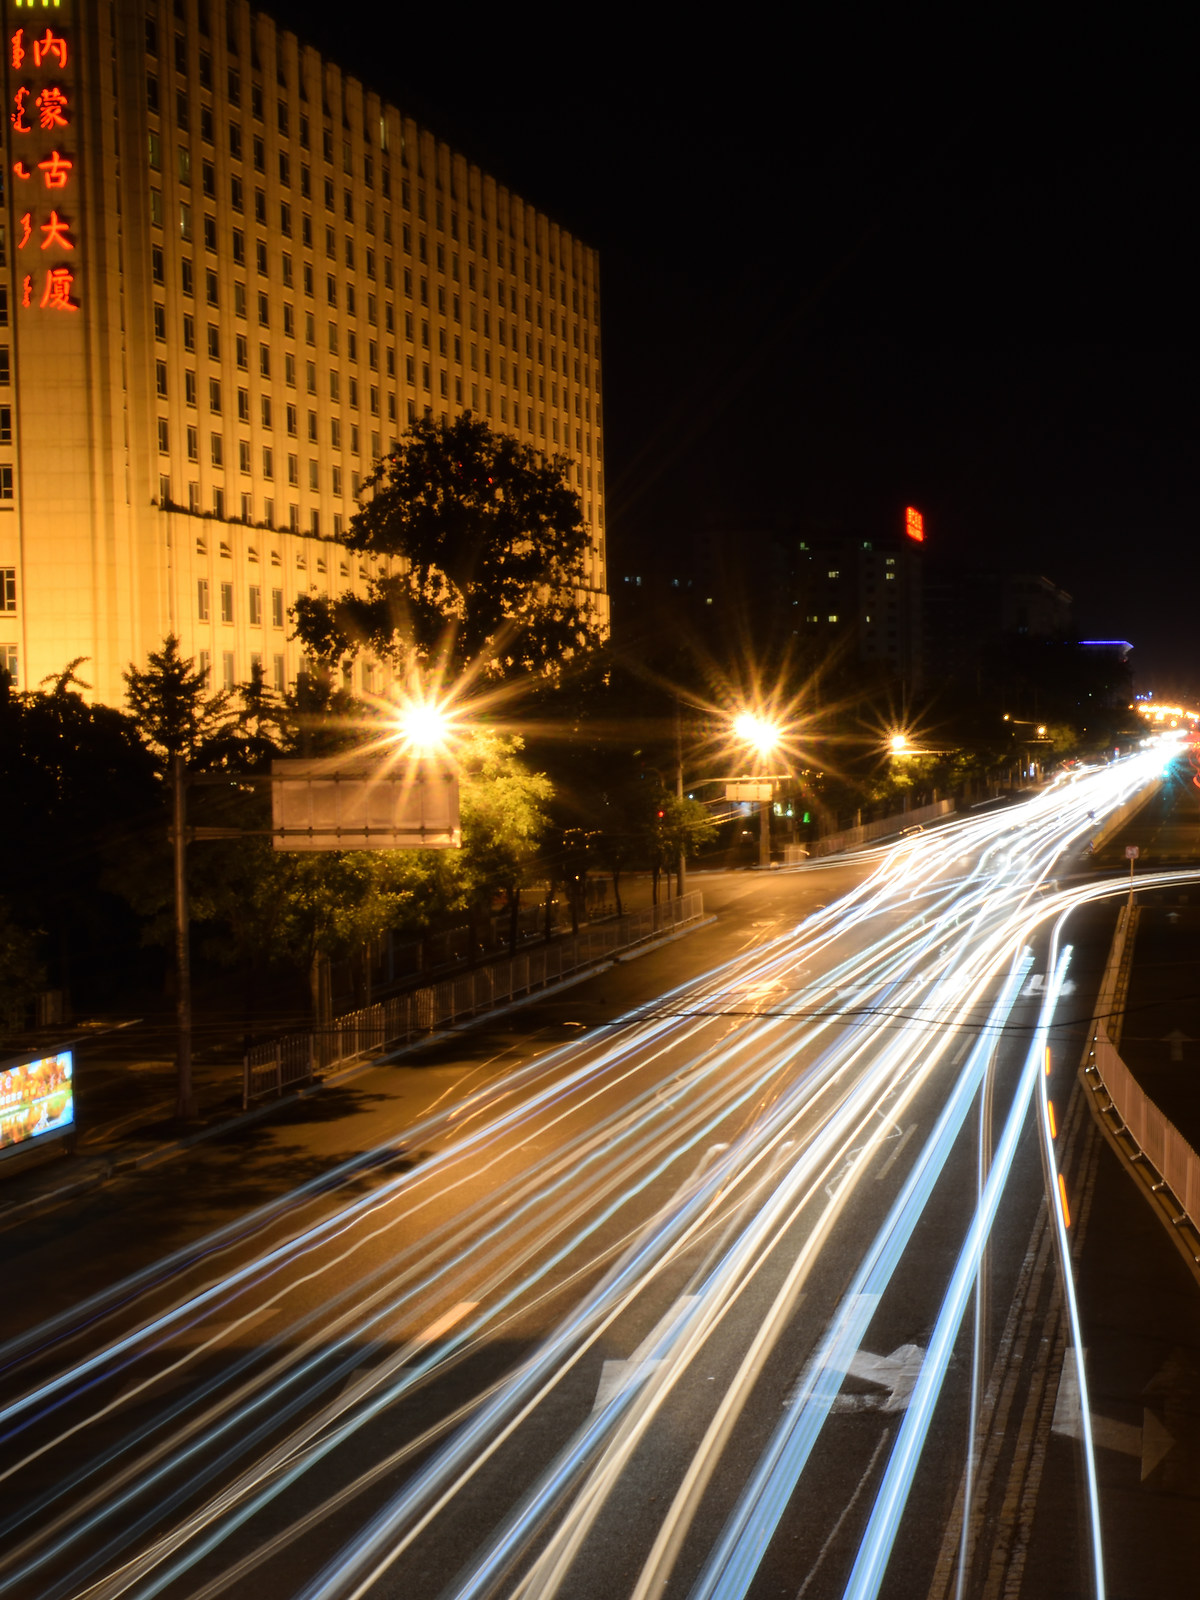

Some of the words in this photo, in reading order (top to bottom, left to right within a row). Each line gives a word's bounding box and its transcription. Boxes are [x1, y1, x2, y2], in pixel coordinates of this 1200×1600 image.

[33, 28, 79, 312] 内蒙古大厦
